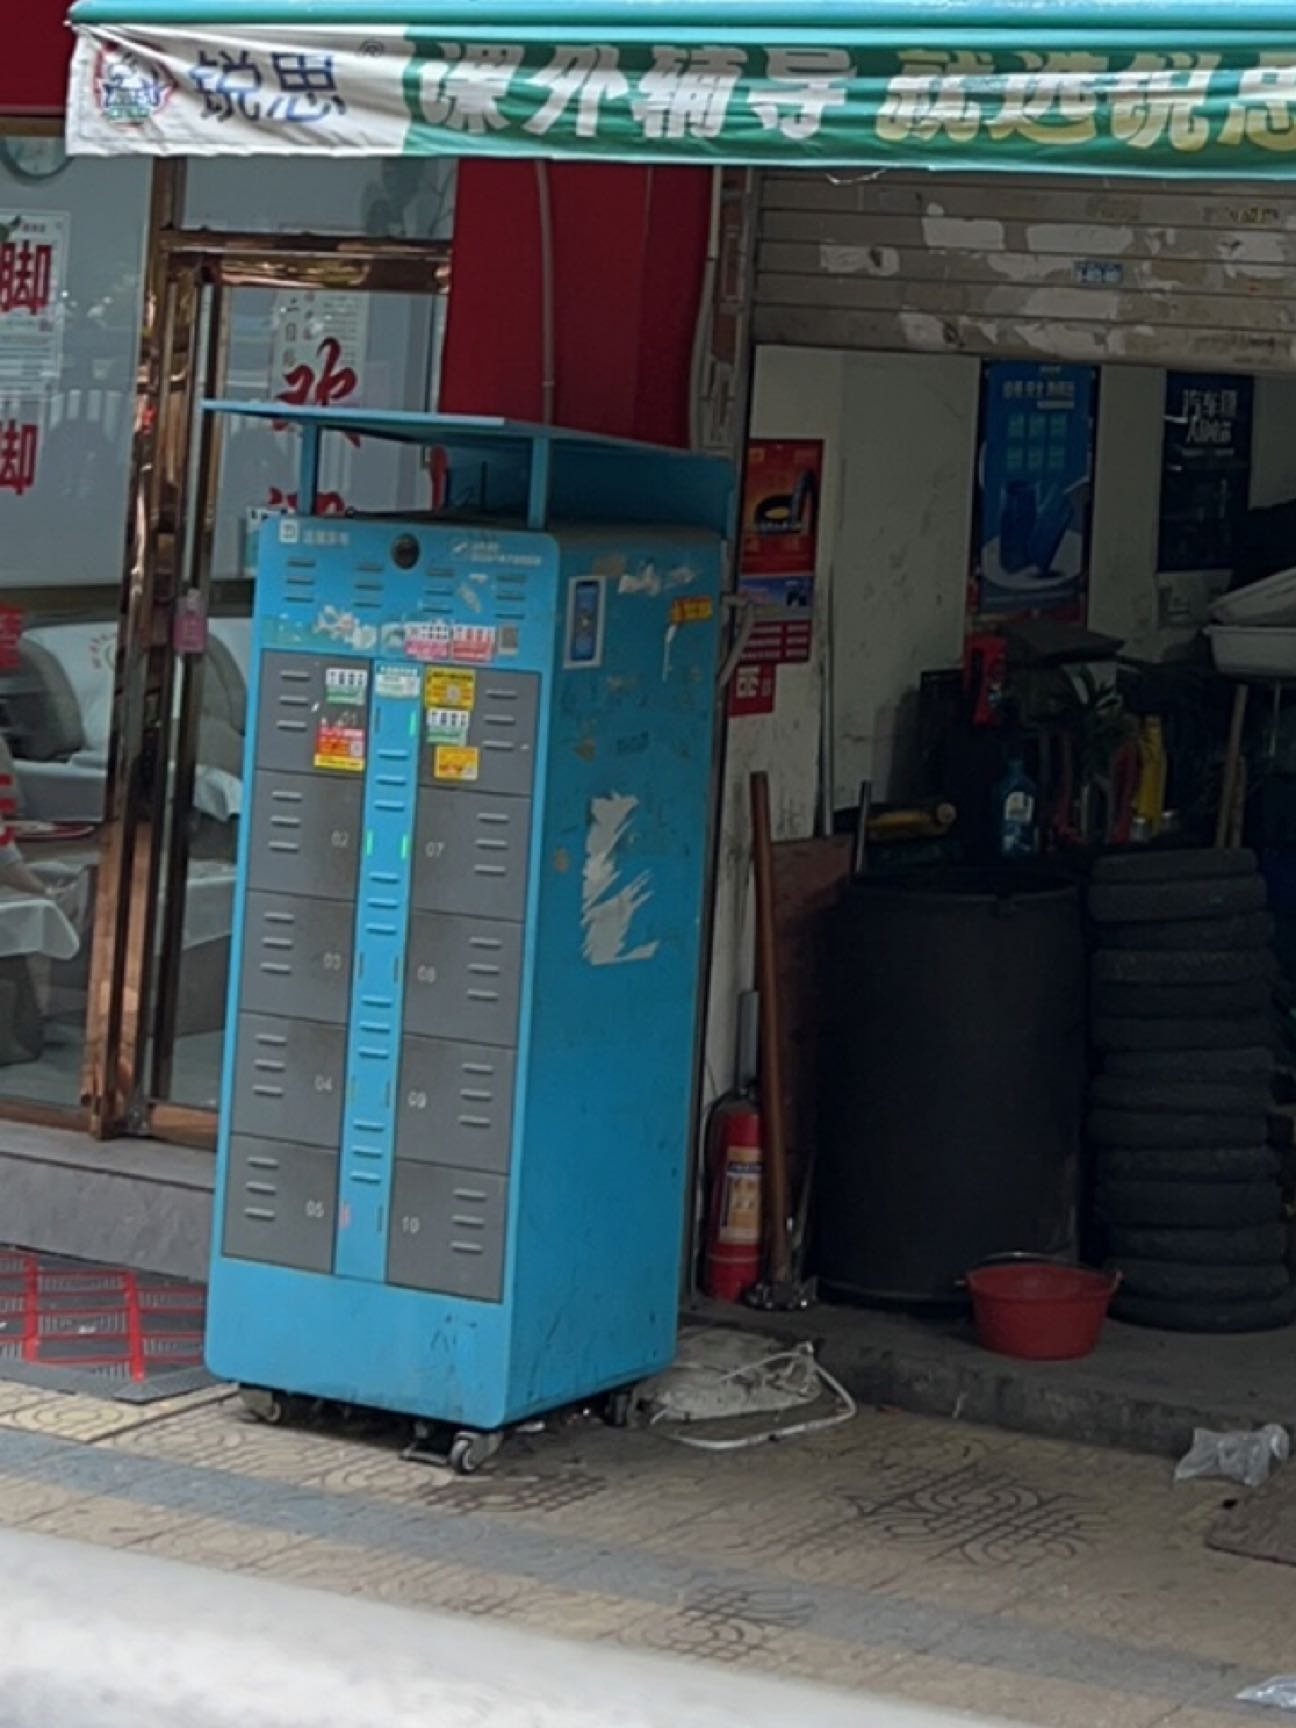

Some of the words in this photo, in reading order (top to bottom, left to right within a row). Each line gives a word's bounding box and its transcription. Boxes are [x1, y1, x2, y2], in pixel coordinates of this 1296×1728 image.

[195, 50, 347, 123] 锐思
[417, 43, 851, 139] 课外辅导
[425, 842, 446, 858] 07
